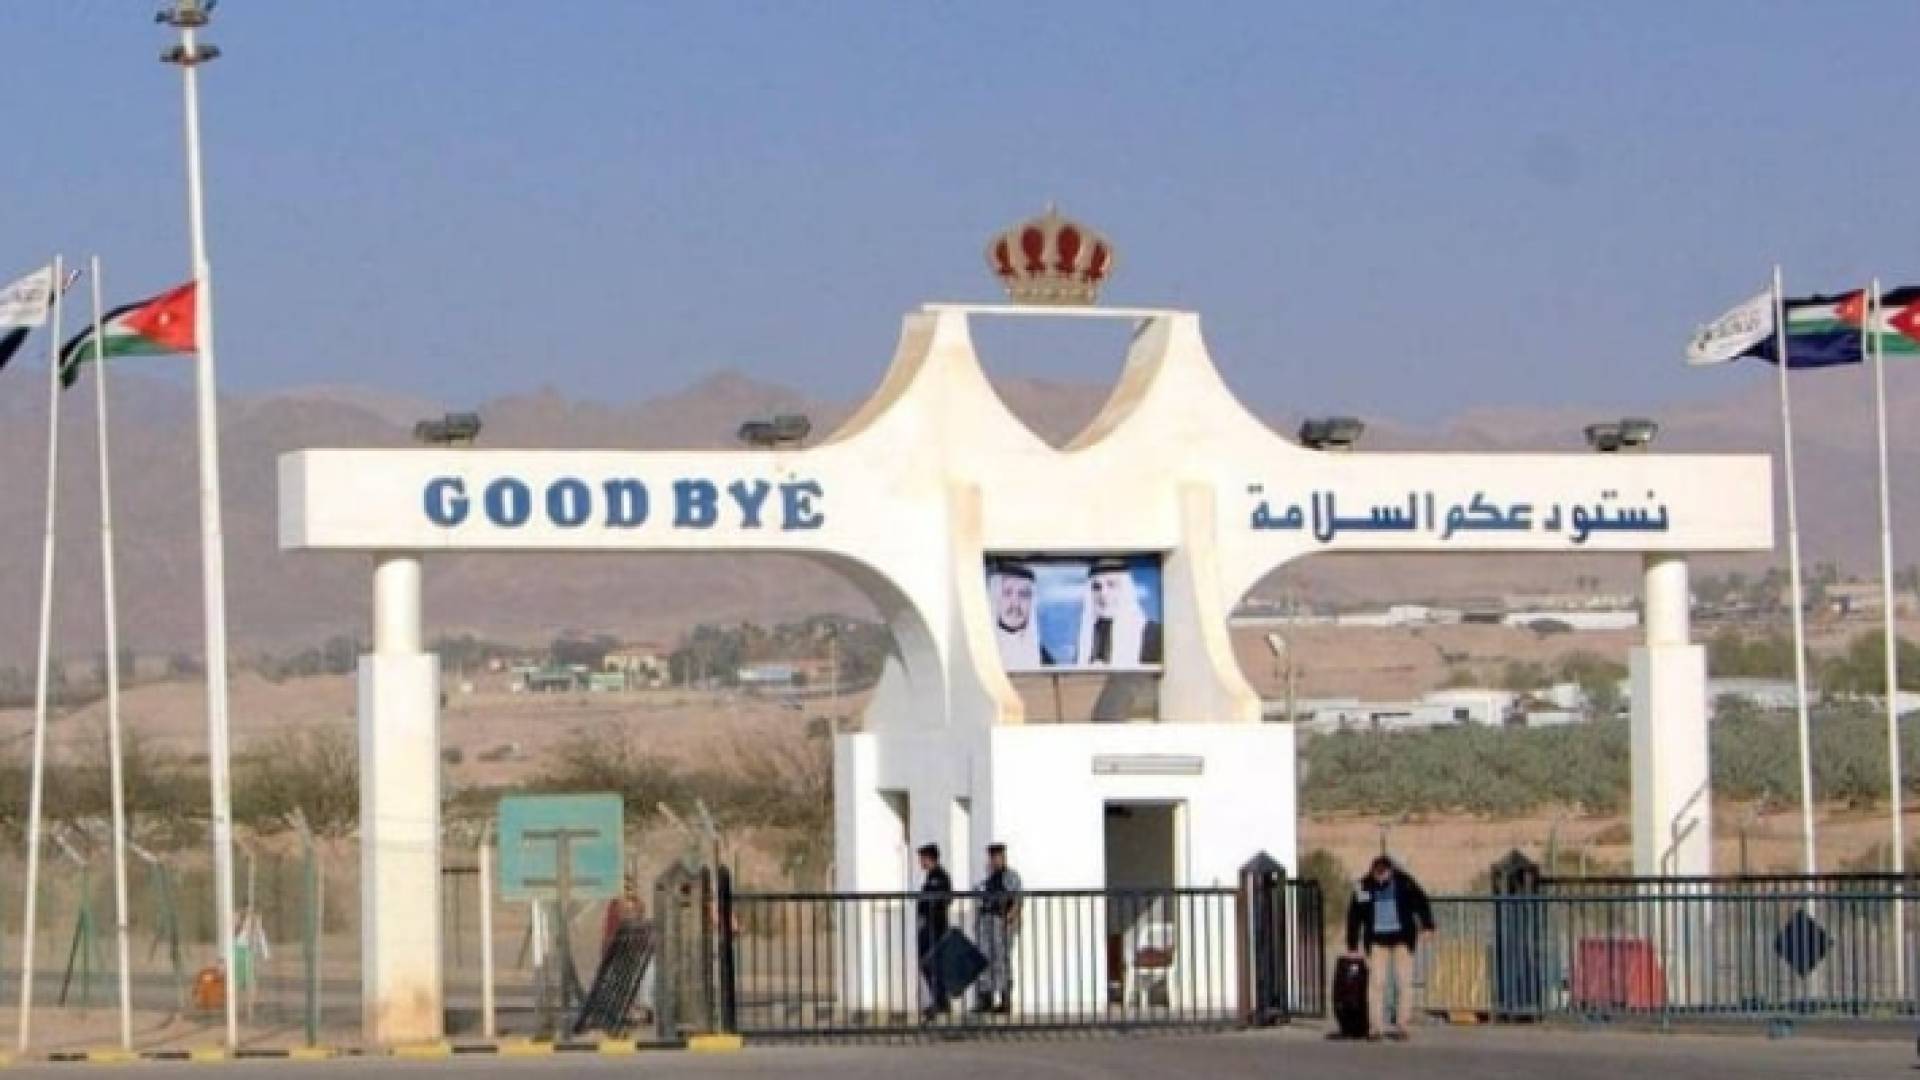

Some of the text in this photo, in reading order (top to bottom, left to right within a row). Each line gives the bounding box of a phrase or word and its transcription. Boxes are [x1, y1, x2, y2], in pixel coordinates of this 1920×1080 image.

[423, 476, 825, 530] GOOD BYE
[1247, 483, 1436, 543] السلامة
